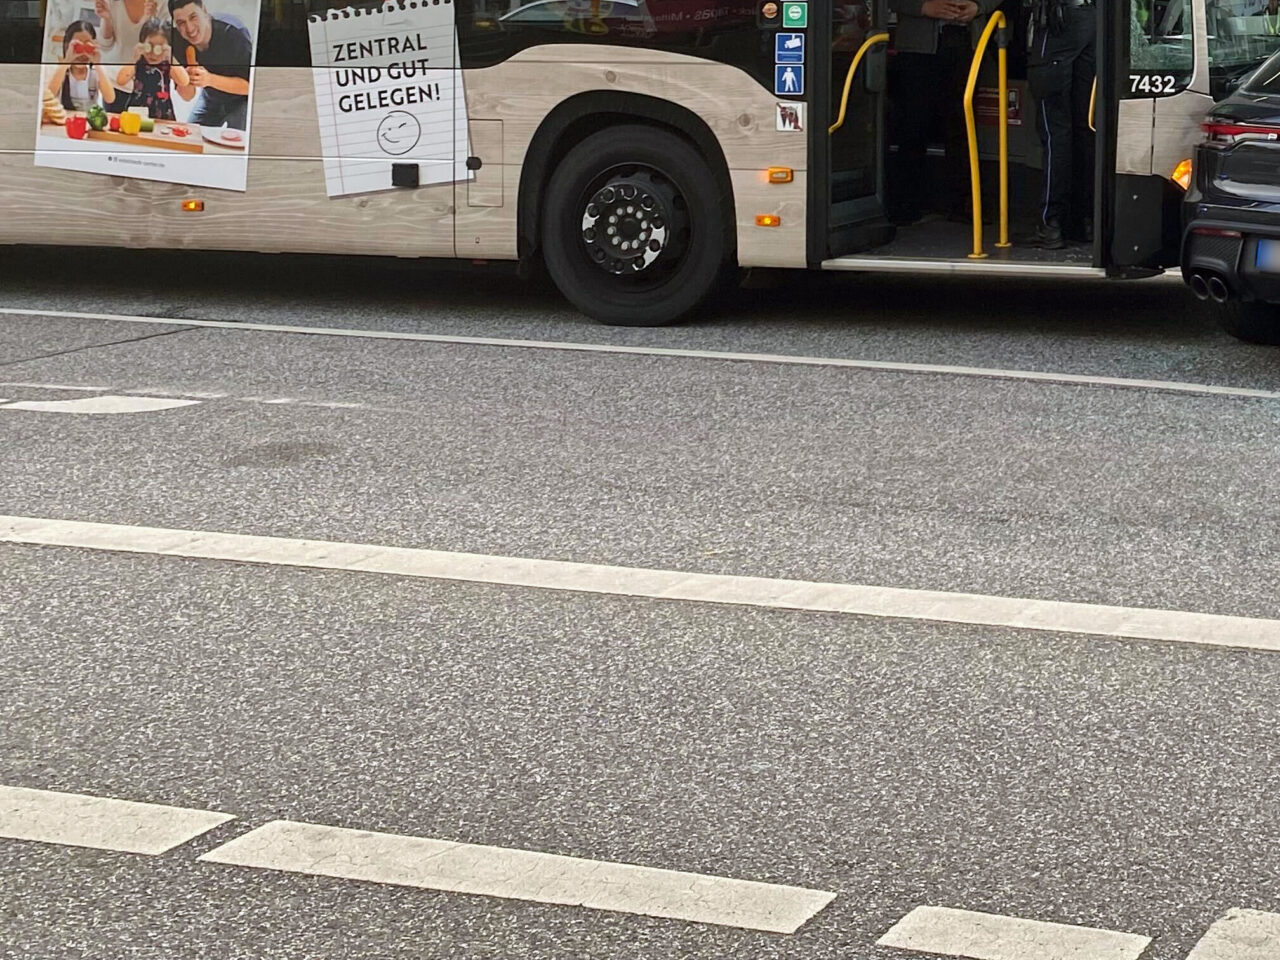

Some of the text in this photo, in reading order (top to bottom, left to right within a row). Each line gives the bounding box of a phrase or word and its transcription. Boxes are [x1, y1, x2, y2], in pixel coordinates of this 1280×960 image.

[332, 33, 427, 62] ZENTRAL
[335, 58, 429, 87] UND GUT
[1129, 75, 1176, 93] 7432
[338, 83, 440, 113] GELEGEN!
